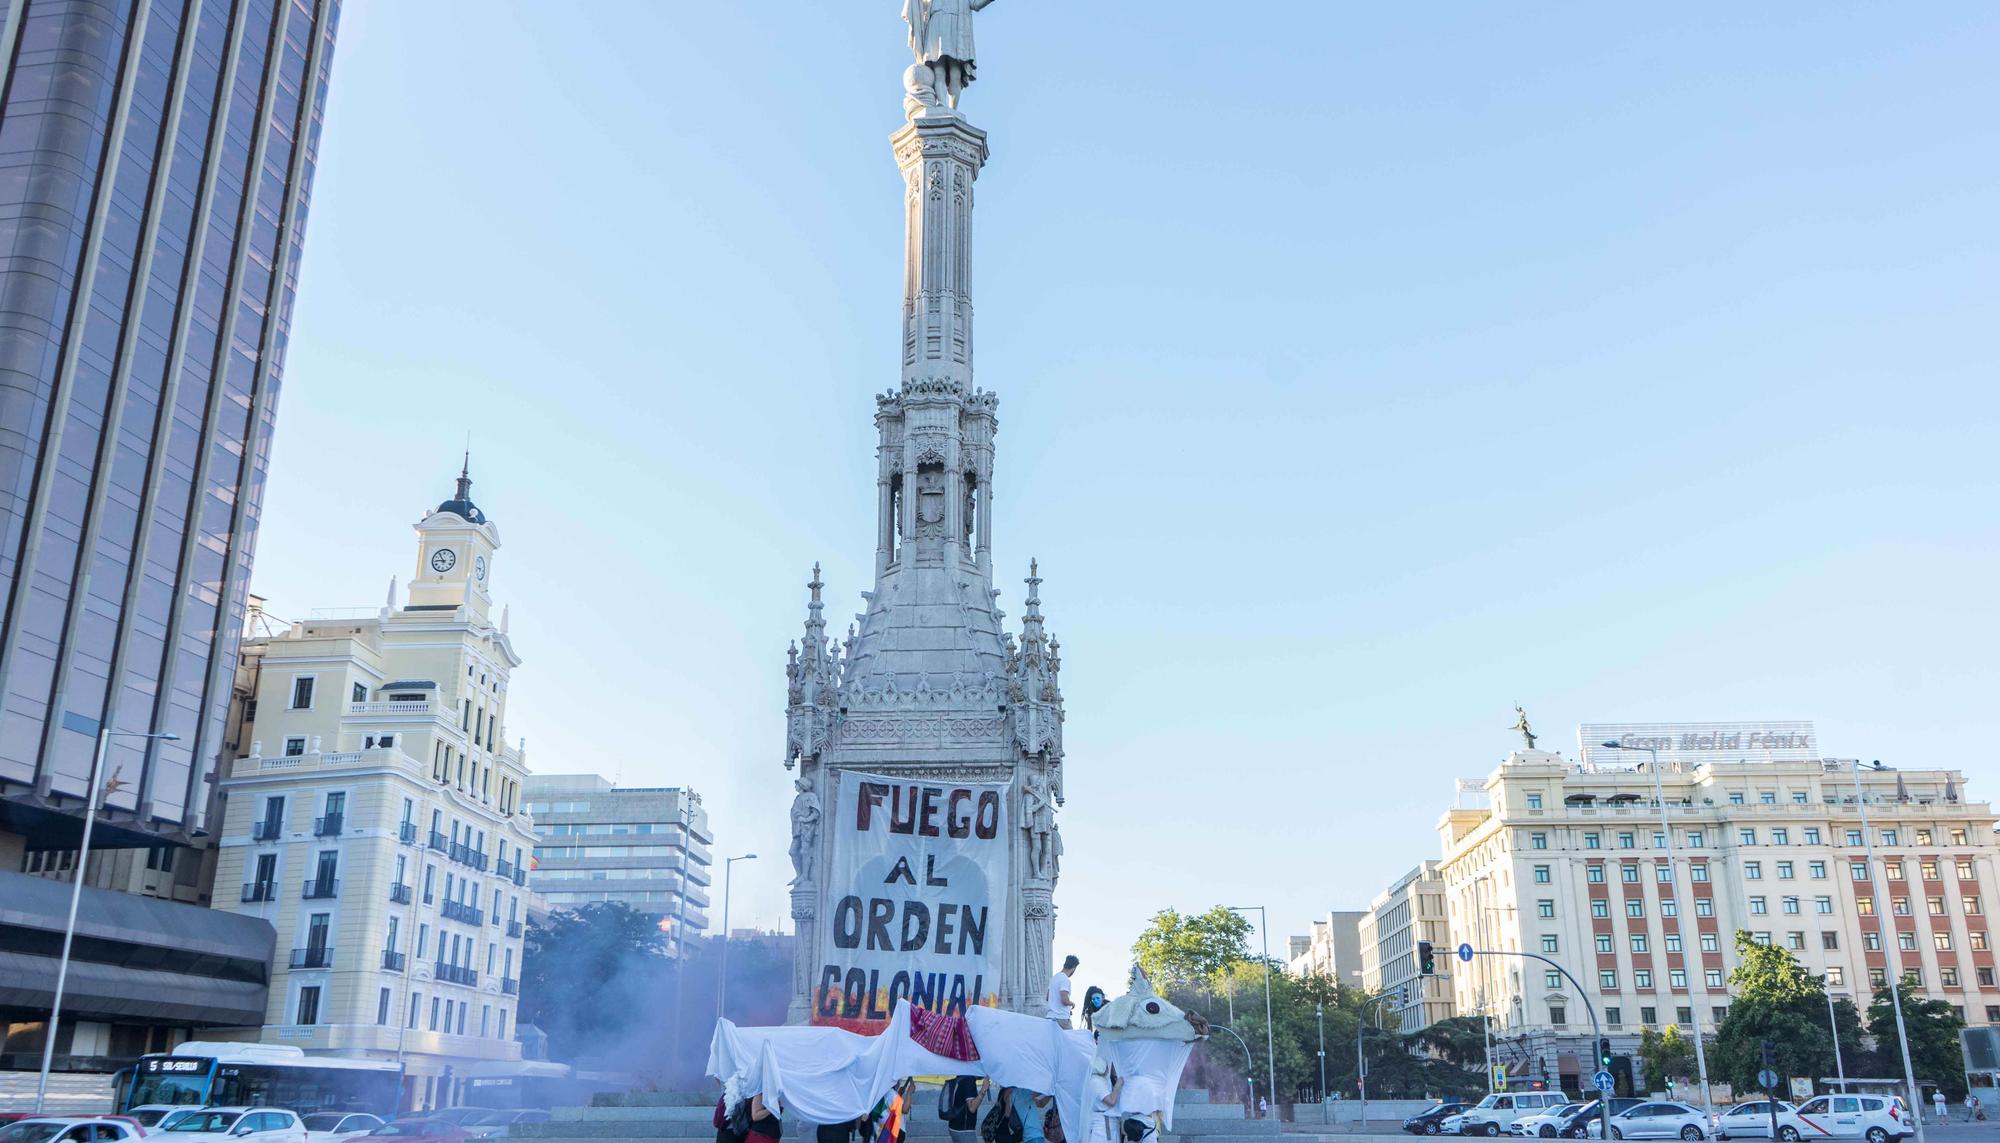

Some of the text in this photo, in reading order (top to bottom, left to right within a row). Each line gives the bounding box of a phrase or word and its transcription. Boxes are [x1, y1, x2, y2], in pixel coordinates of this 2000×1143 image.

[1621, 733, 1672, 751] Gran
[1748, 731, 1809, 749] Fénix
[856, 782, 1000, 839] FUEGO
[884, 854, 948, 887] AL
[833, 895, 988, 955] ORDEN
[149, 1060, 159, 1072] 5
